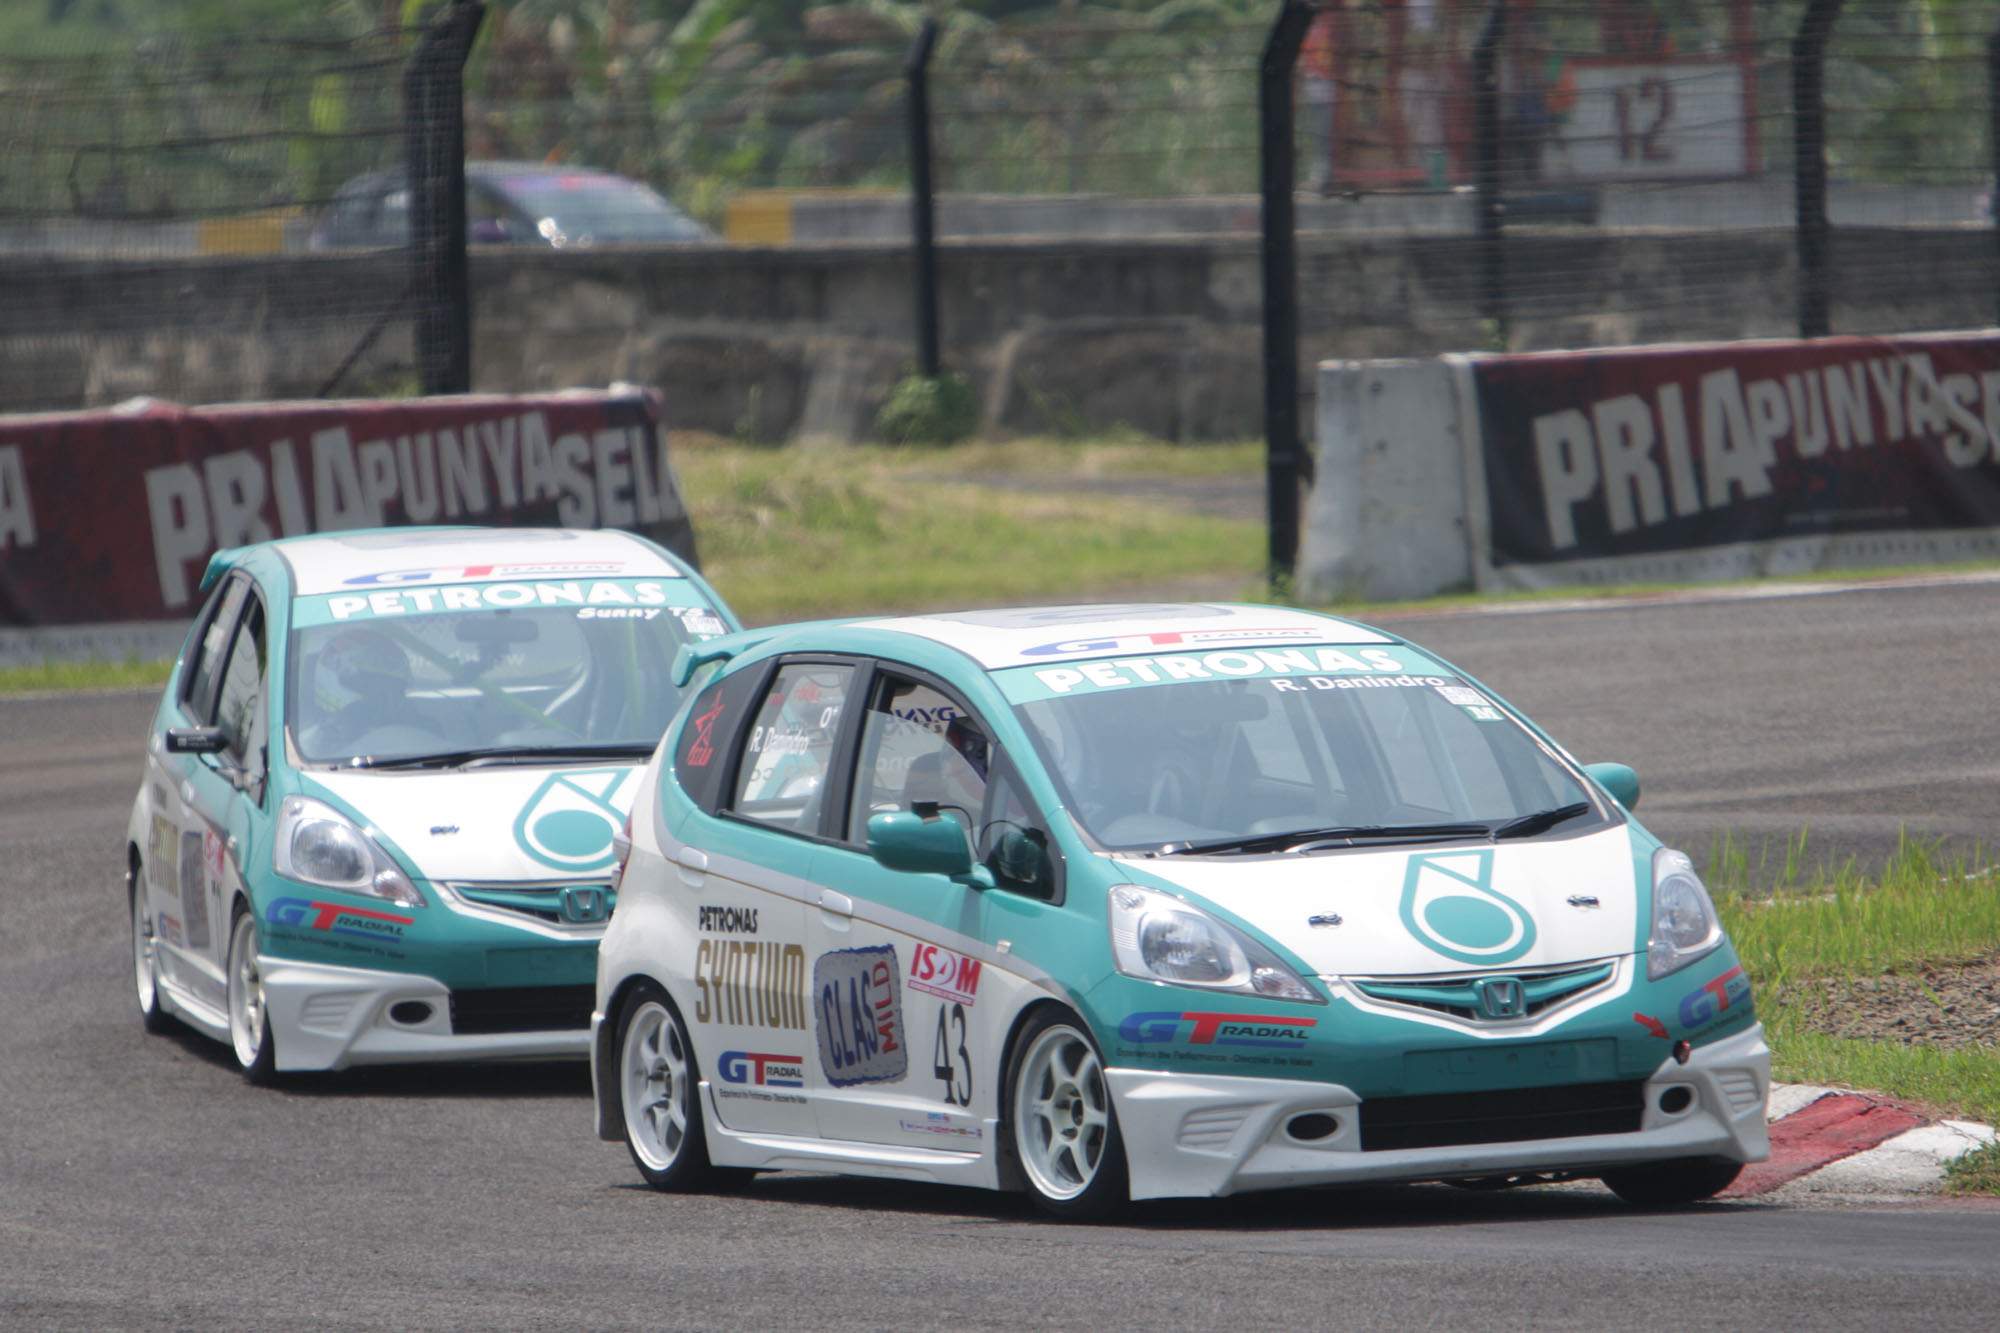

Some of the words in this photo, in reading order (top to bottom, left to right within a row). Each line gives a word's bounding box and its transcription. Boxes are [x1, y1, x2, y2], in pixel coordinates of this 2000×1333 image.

[1616, 76, 1677, 160] 12
[328, 582, 667, 620] PETRONAS
[576, 607, 661, 620] Sunny
[1034, 648, 1404, 693] PETRONAS
[1270, 678, 1307, 692] R.
[1307, 675, 1445, 690] Danindro
[698, 905, 758, 934] PETRONAS
[823, 970, 879, 1070] CLAS
[871, 960, 899, 1055] MILD
[1221, 1025, 1310, 1040] RADIAL
[766, 1065, 803, 1078] RADIAL
[934, 1002, 973, 1108] 43
